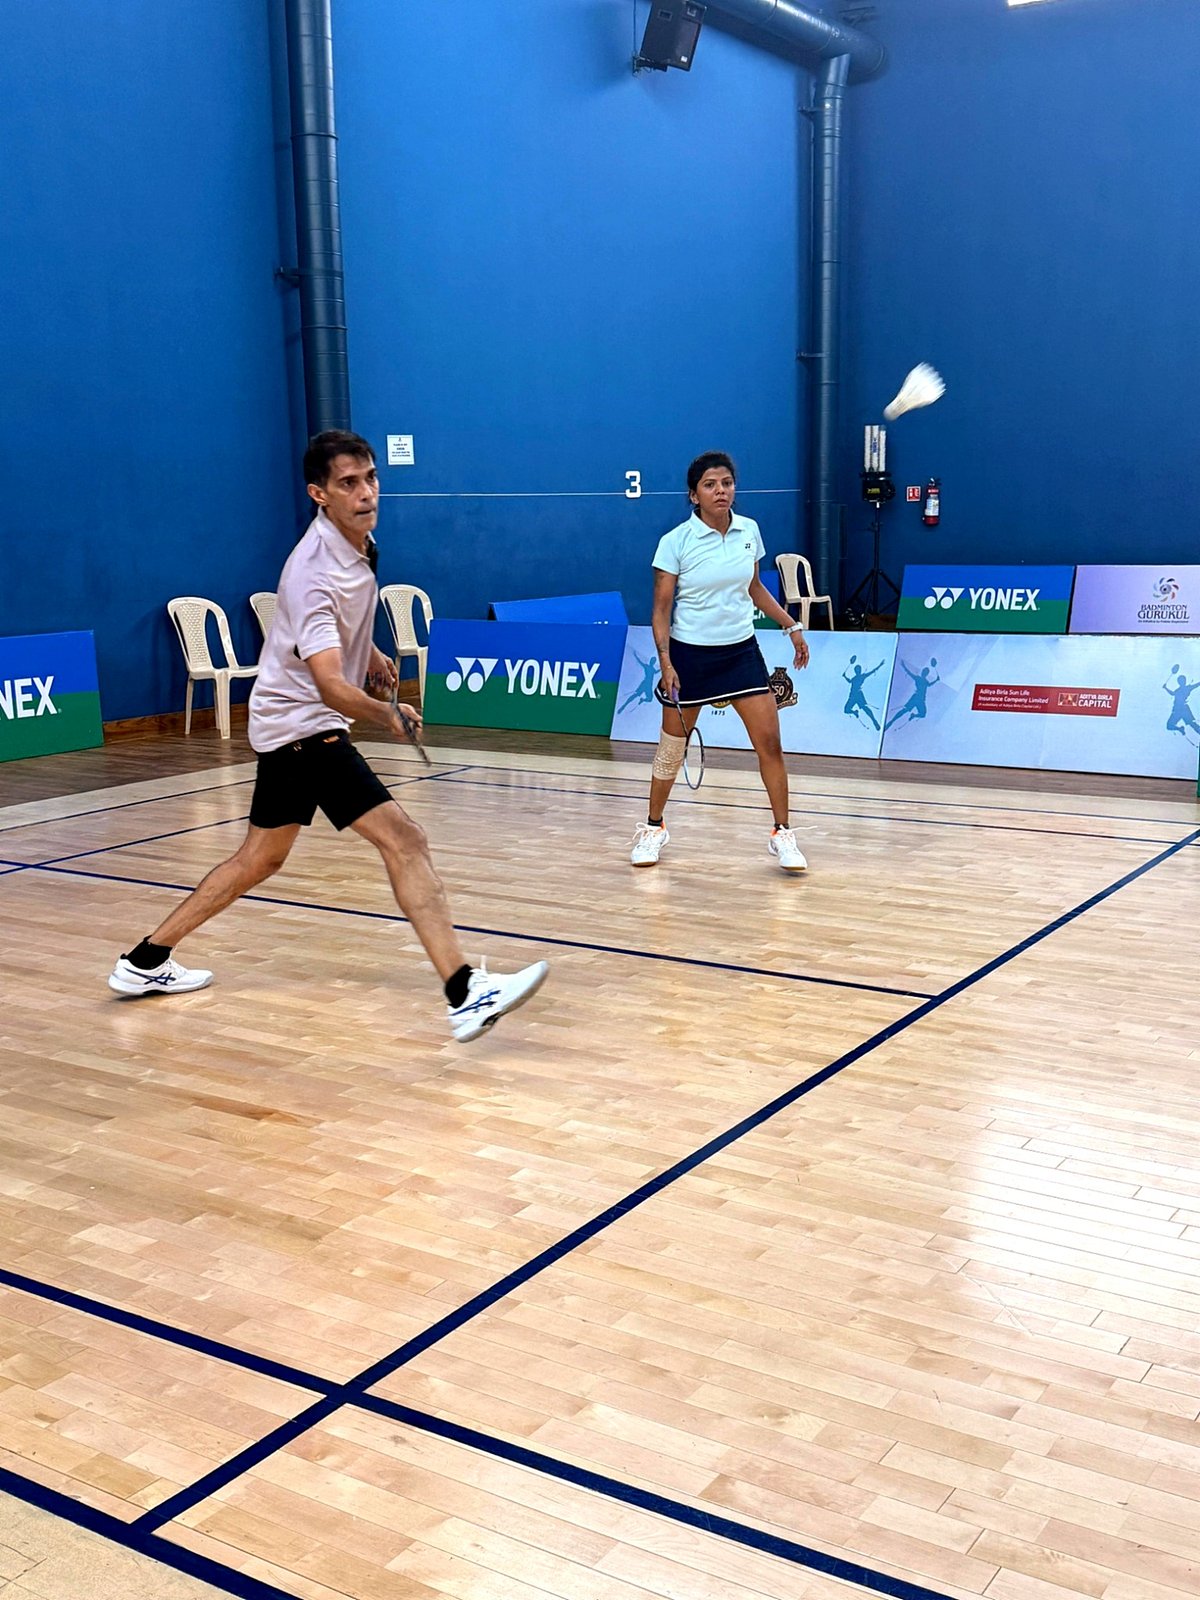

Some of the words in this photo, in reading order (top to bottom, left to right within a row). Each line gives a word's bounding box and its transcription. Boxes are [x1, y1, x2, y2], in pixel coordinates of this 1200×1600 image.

[625, 470, 642, 499] 3
[968, 587, 1040, 611] YONEX
[1137, 610, 1190, 620] GURUKUL
[504, 659, 600, 699] YONEX
[979, 688, 996, 696] Aditya
[1003, 695, 1028, 704] Company
[1078, 699, 1112, 709] CAPITAL
